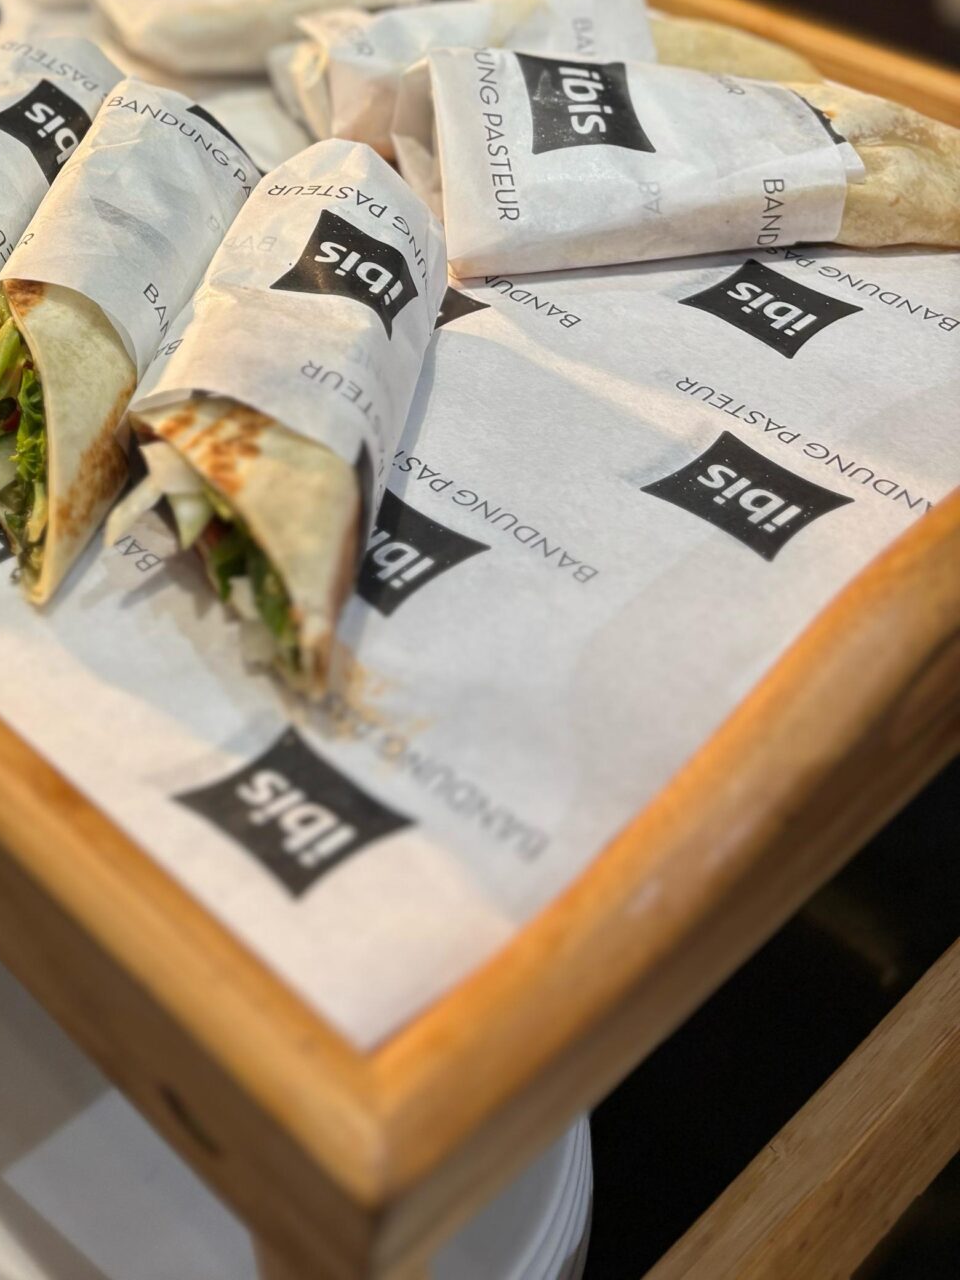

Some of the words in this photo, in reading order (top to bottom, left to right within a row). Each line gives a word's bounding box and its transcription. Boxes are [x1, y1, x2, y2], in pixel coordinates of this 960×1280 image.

[473, 47, 501, 106] UNG
[558, 66, 614, 136] ibis
[23, 102, 80, 165] bis
[107, 95, 230, 167] BANDUNG
[482, 111, 521, 222] PASTEUR
[267, 184, 388, 219] PASTEUR
[756, 178, 786, 247] BAND
[314, 241, 405, 306] ibis
[817, 266, 960, 333] BANDUNG
[726, 281, 818, 337] ibis
[675, 376, 802, 444] PASTEUR
[697, 463, 803, 534] ibis
[802, 442, 935, 514] NDUNG
[370, 525, 436, 590] ib
[451, 488, 600, 585] BANDUNG
[235, 767, 359, 869] ibis
